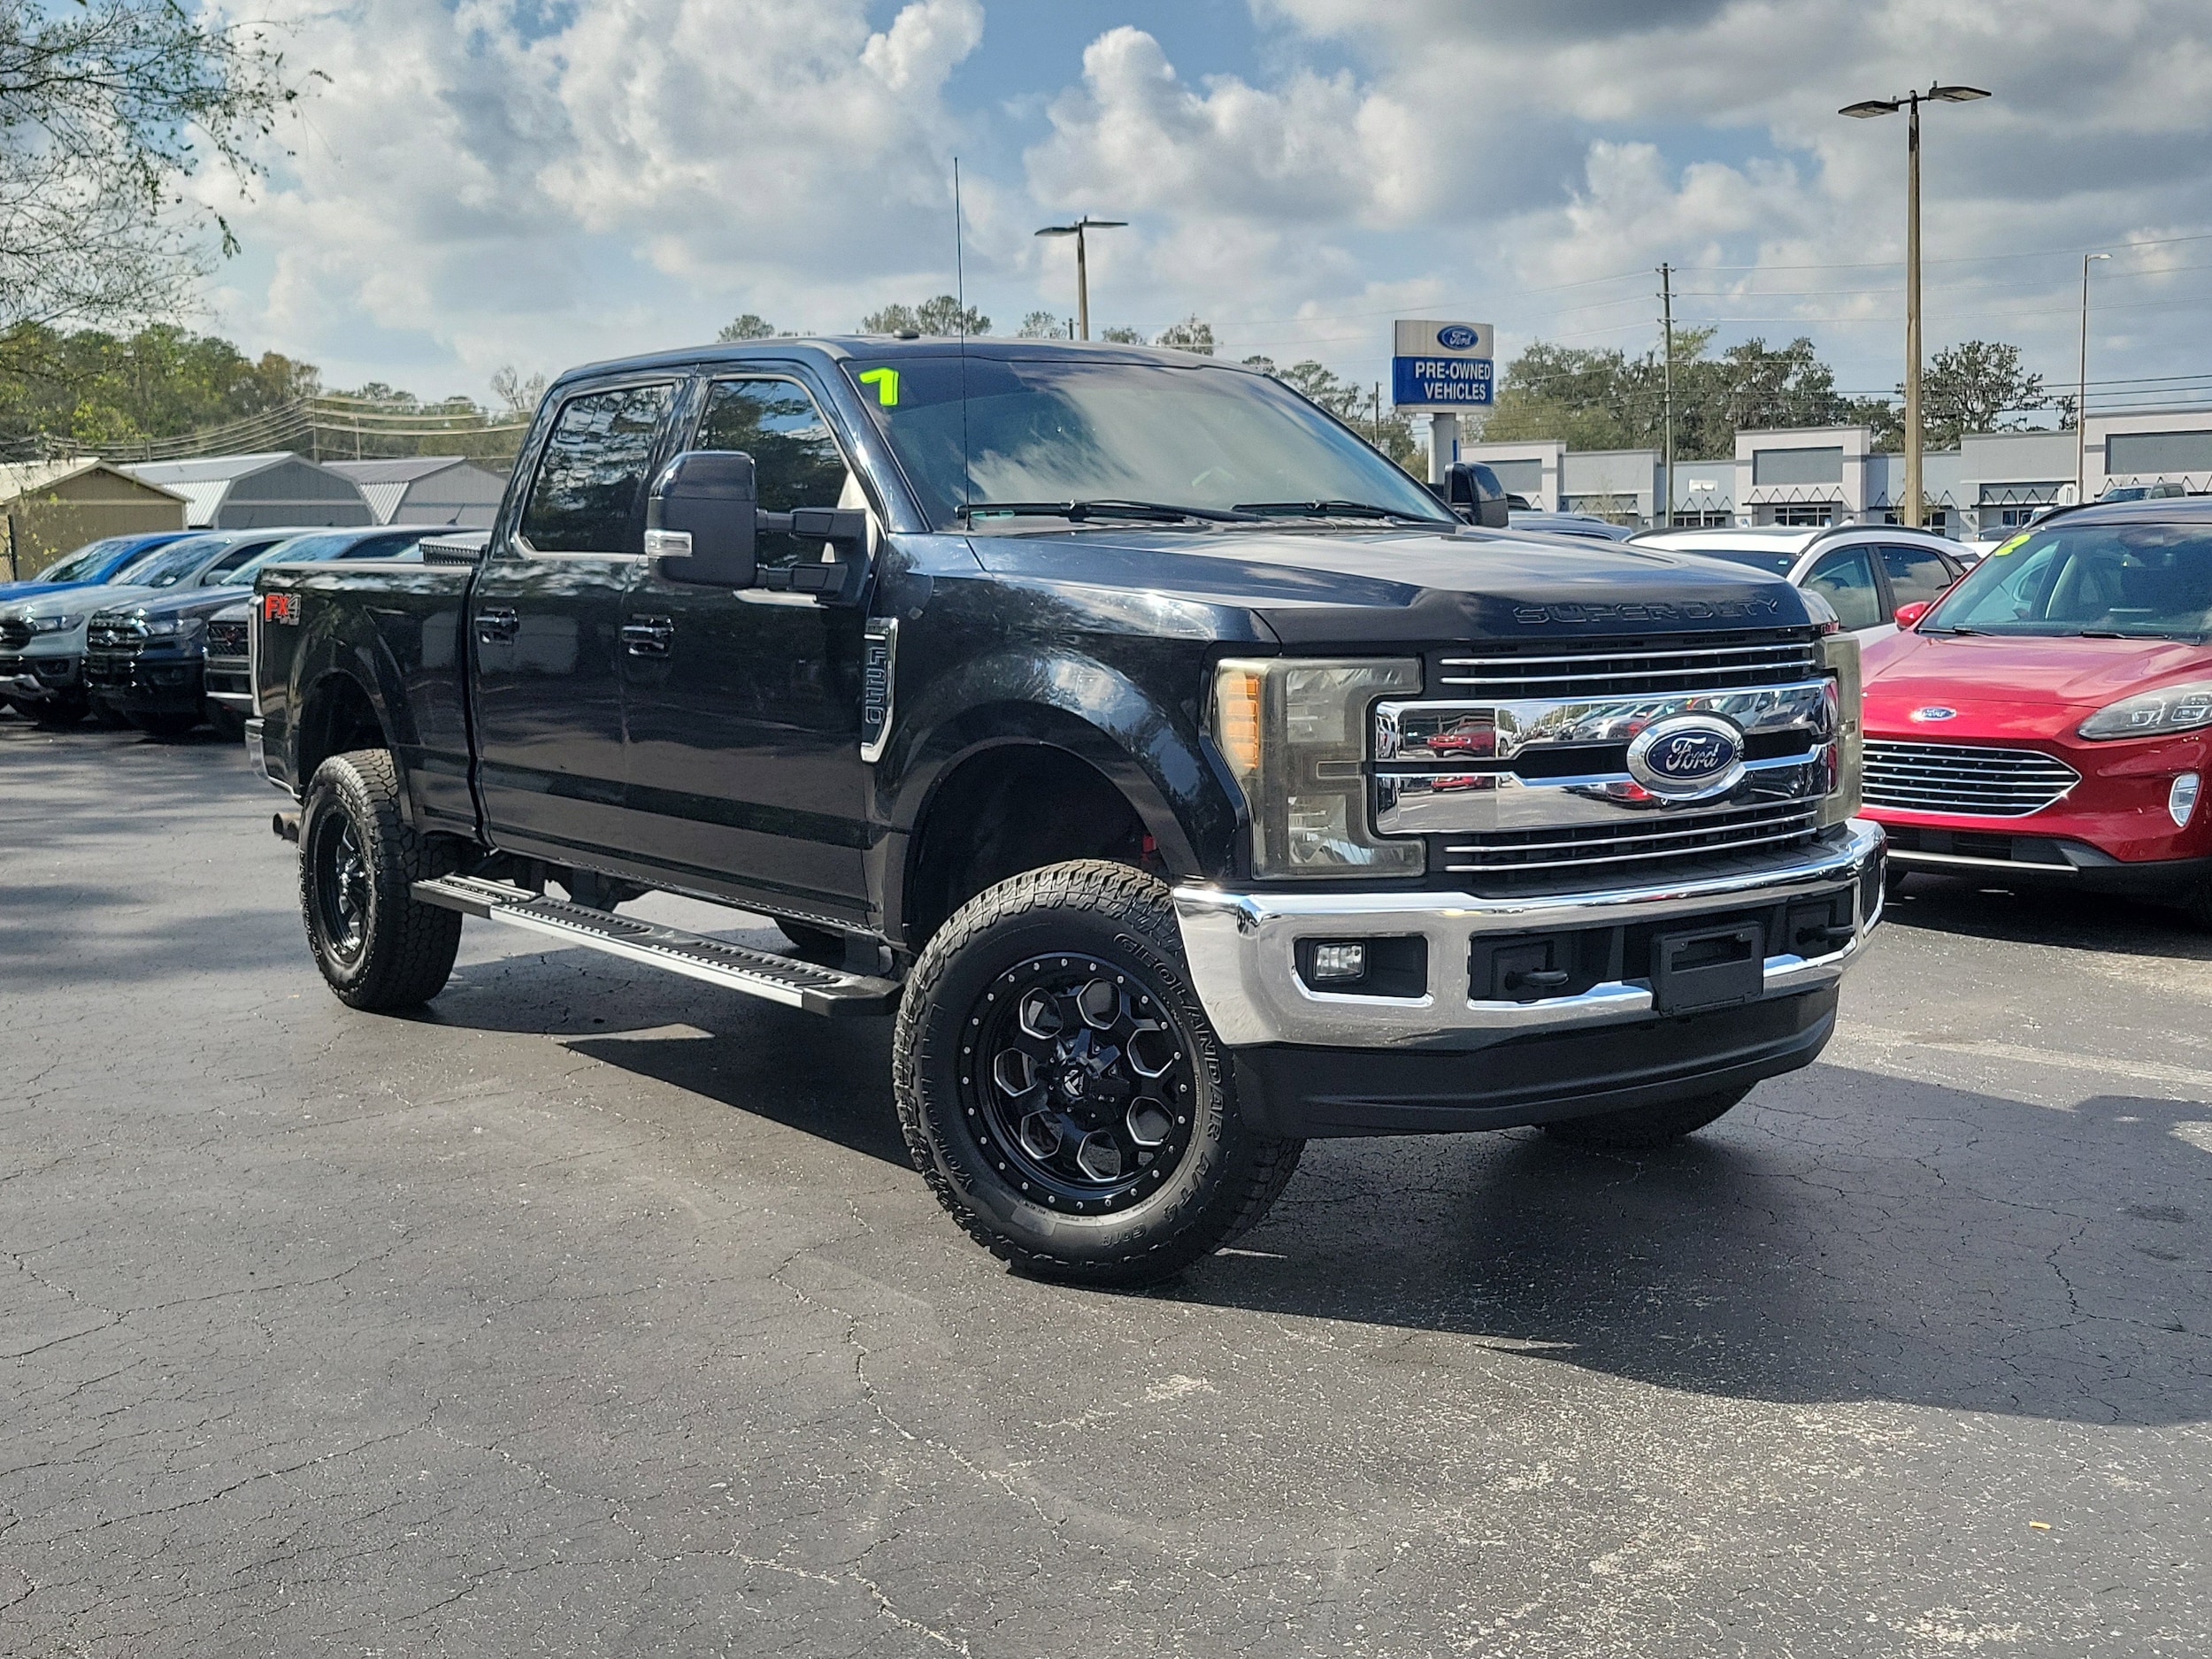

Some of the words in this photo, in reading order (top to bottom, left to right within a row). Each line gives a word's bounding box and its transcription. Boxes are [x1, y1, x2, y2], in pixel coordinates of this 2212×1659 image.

[1449, 330, 1472, 346] Ford
[1416, 361, 1491, 380] PRE-OWNED
[1424, 381, 1486, 400] VEHICLES
[265, 592, 302, 626] FX4
[1512, 603, 1679, 625] SUPER
[1681, 598, 1778, 619] DUTY
[1665, 736, 1720, 771] Ford
